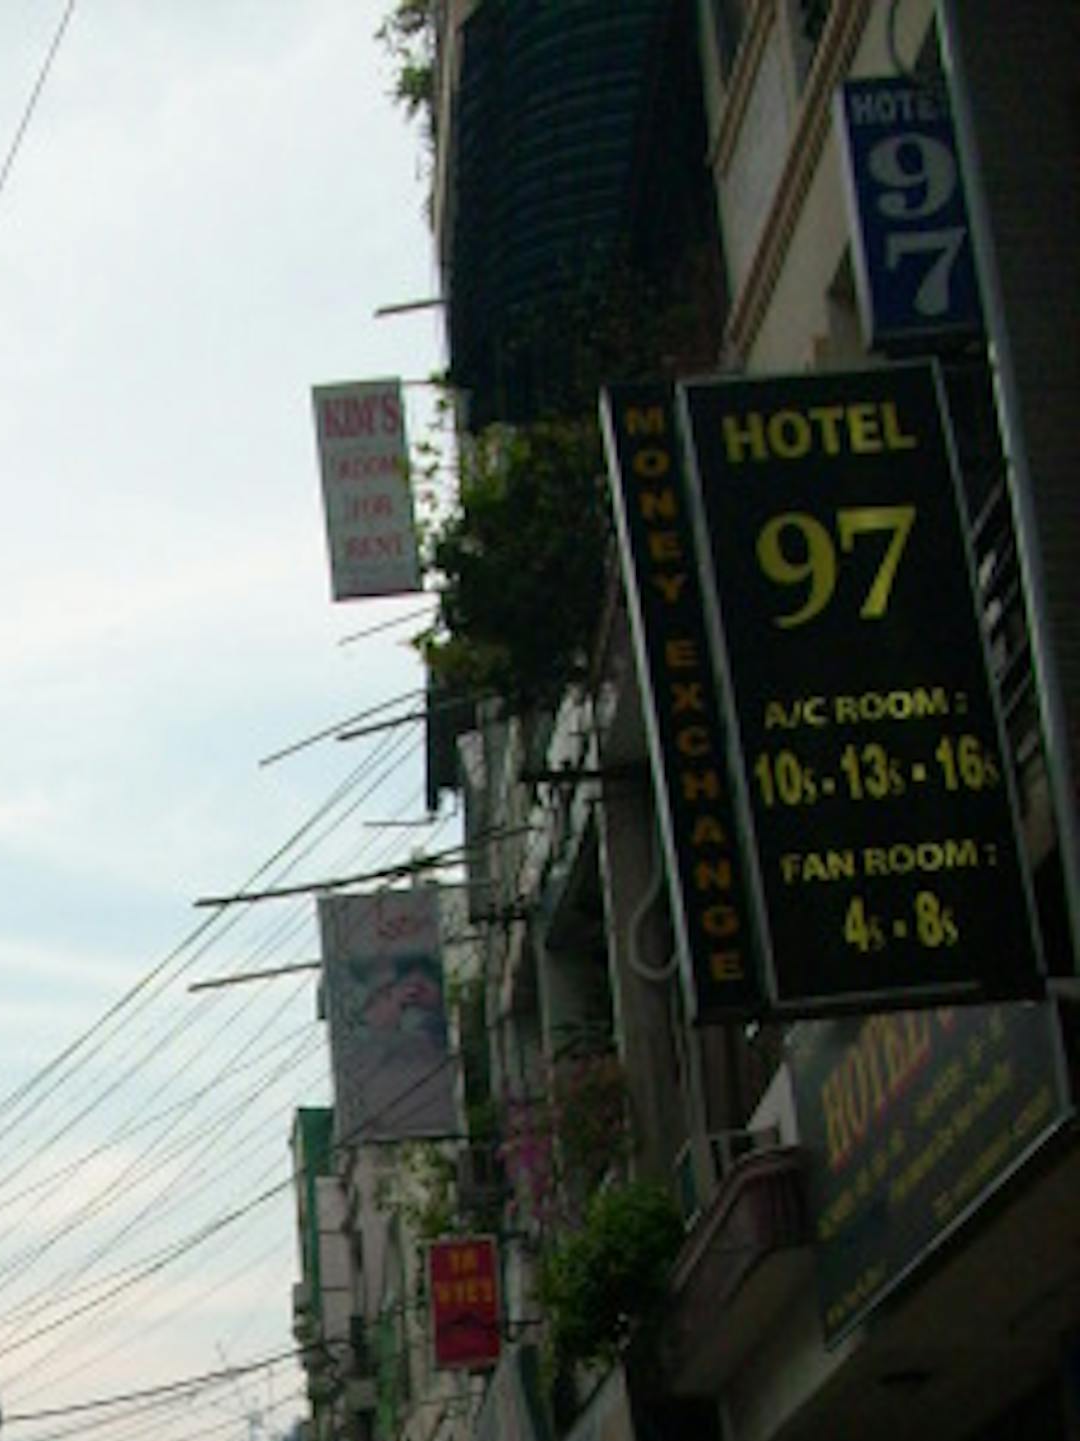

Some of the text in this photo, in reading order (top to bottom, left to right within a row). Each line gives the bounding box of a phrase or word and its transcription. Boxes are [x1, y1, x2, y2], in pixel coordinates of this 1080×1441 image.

[849, 88, 940, 125] HOTE
[866, 134, 968, 316] 97
[721, 398, 918, 465] HOTEL
[754, 502, 918, 632] 97
[623, 402, 746, 986] MONEY EXCHANGE
[762, 693, 829, 731] A/C
[779, 848, 855, 887] FAN
